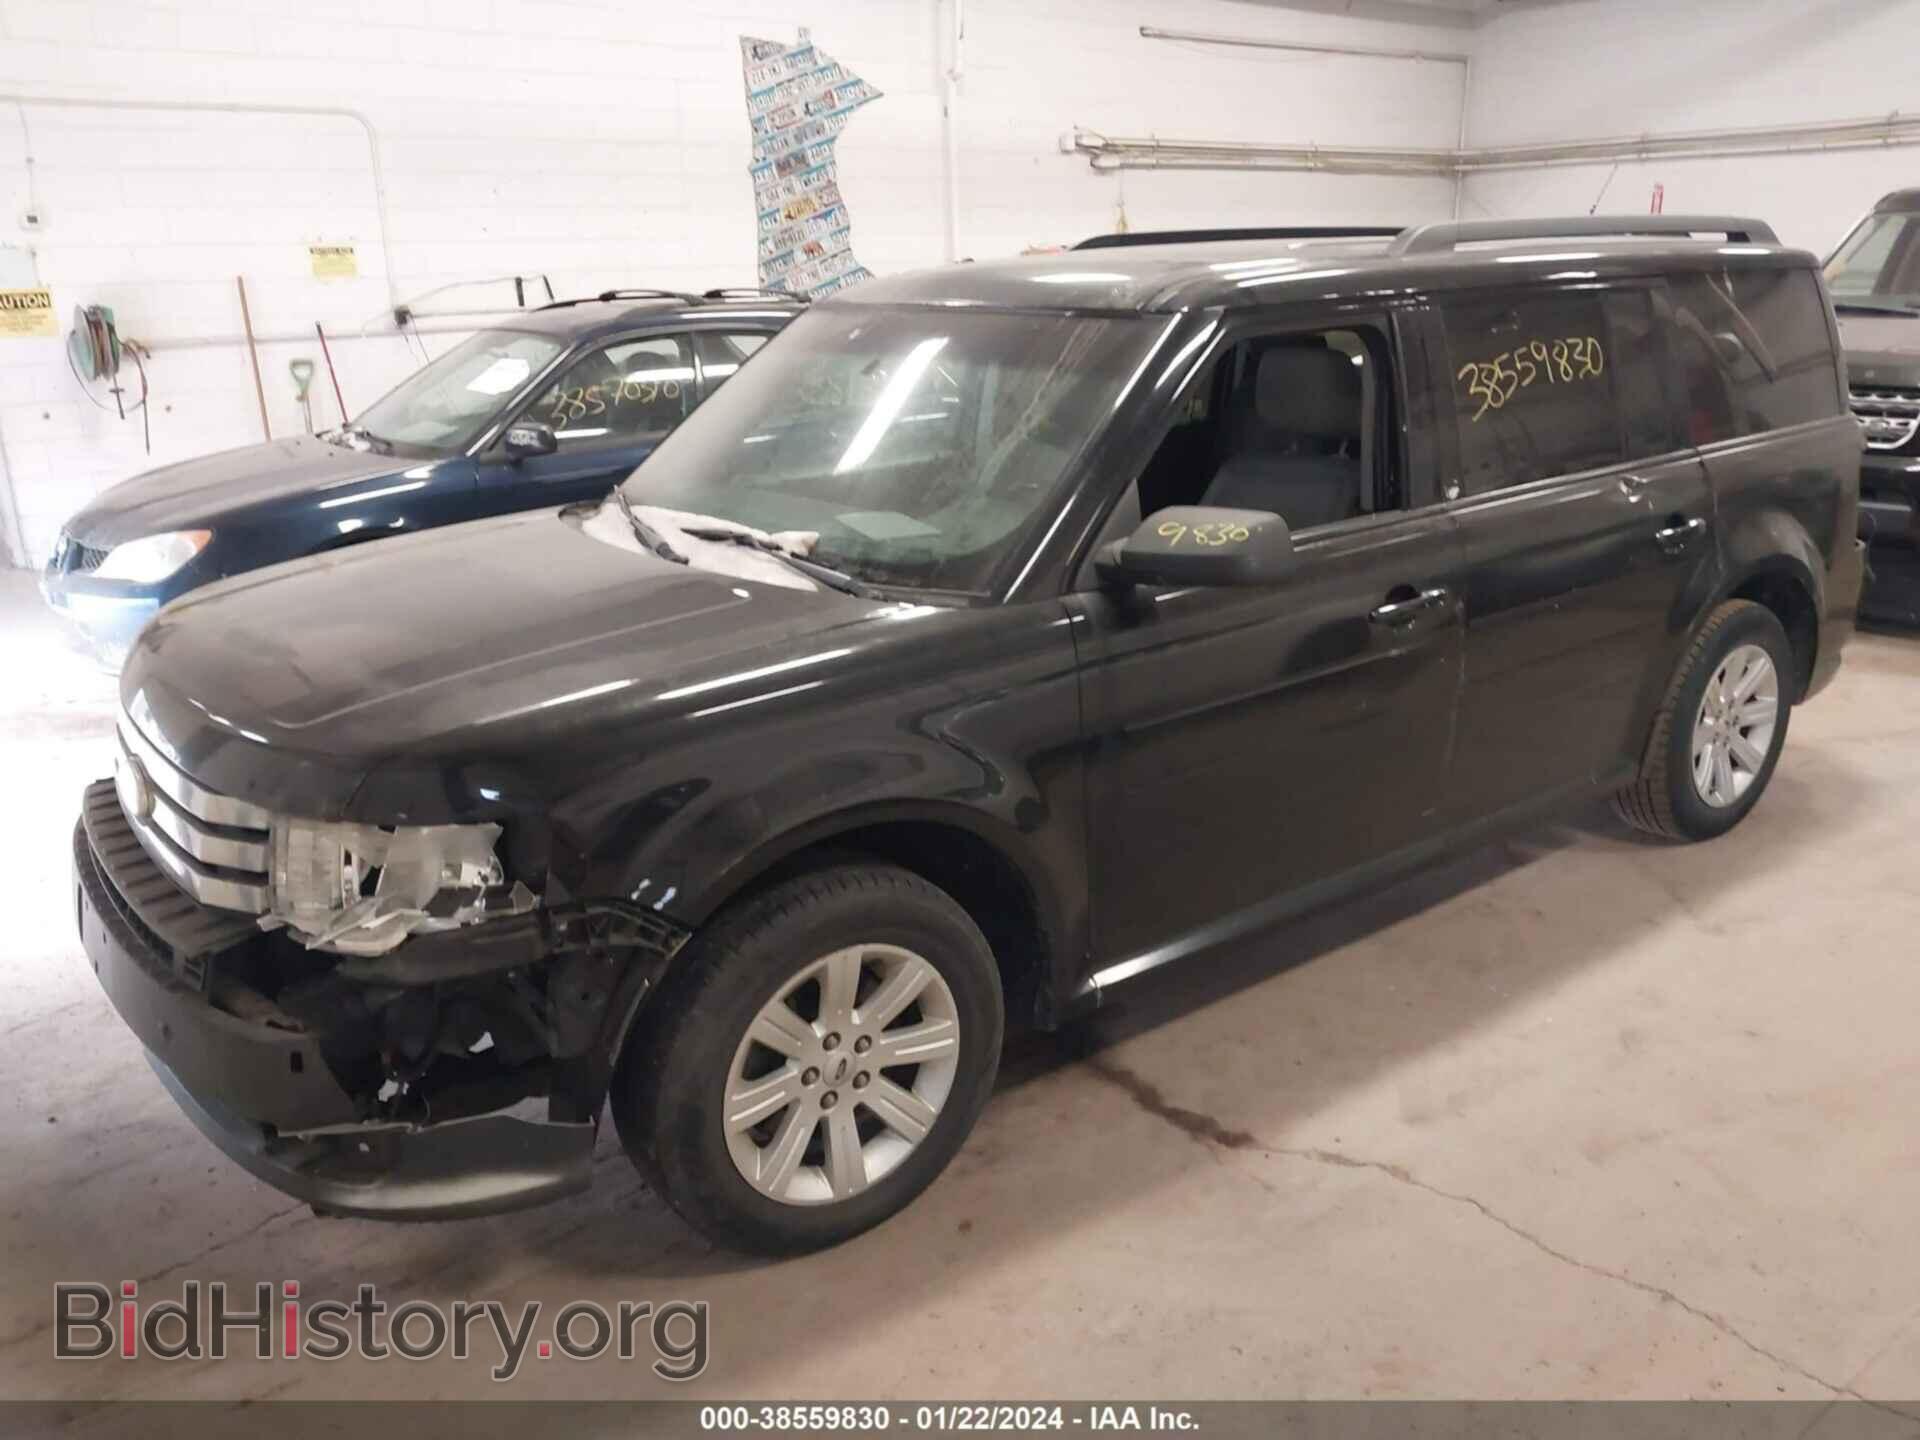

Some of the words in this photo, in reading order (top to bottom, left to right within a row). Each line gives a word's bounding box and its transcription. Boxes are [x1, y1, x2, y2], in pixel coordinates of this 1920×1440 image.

[0, 294, 49, 310] UTION
[1457, 337, 1604, 422] 38559830
[1158, 521, 1249, 547] 9830
